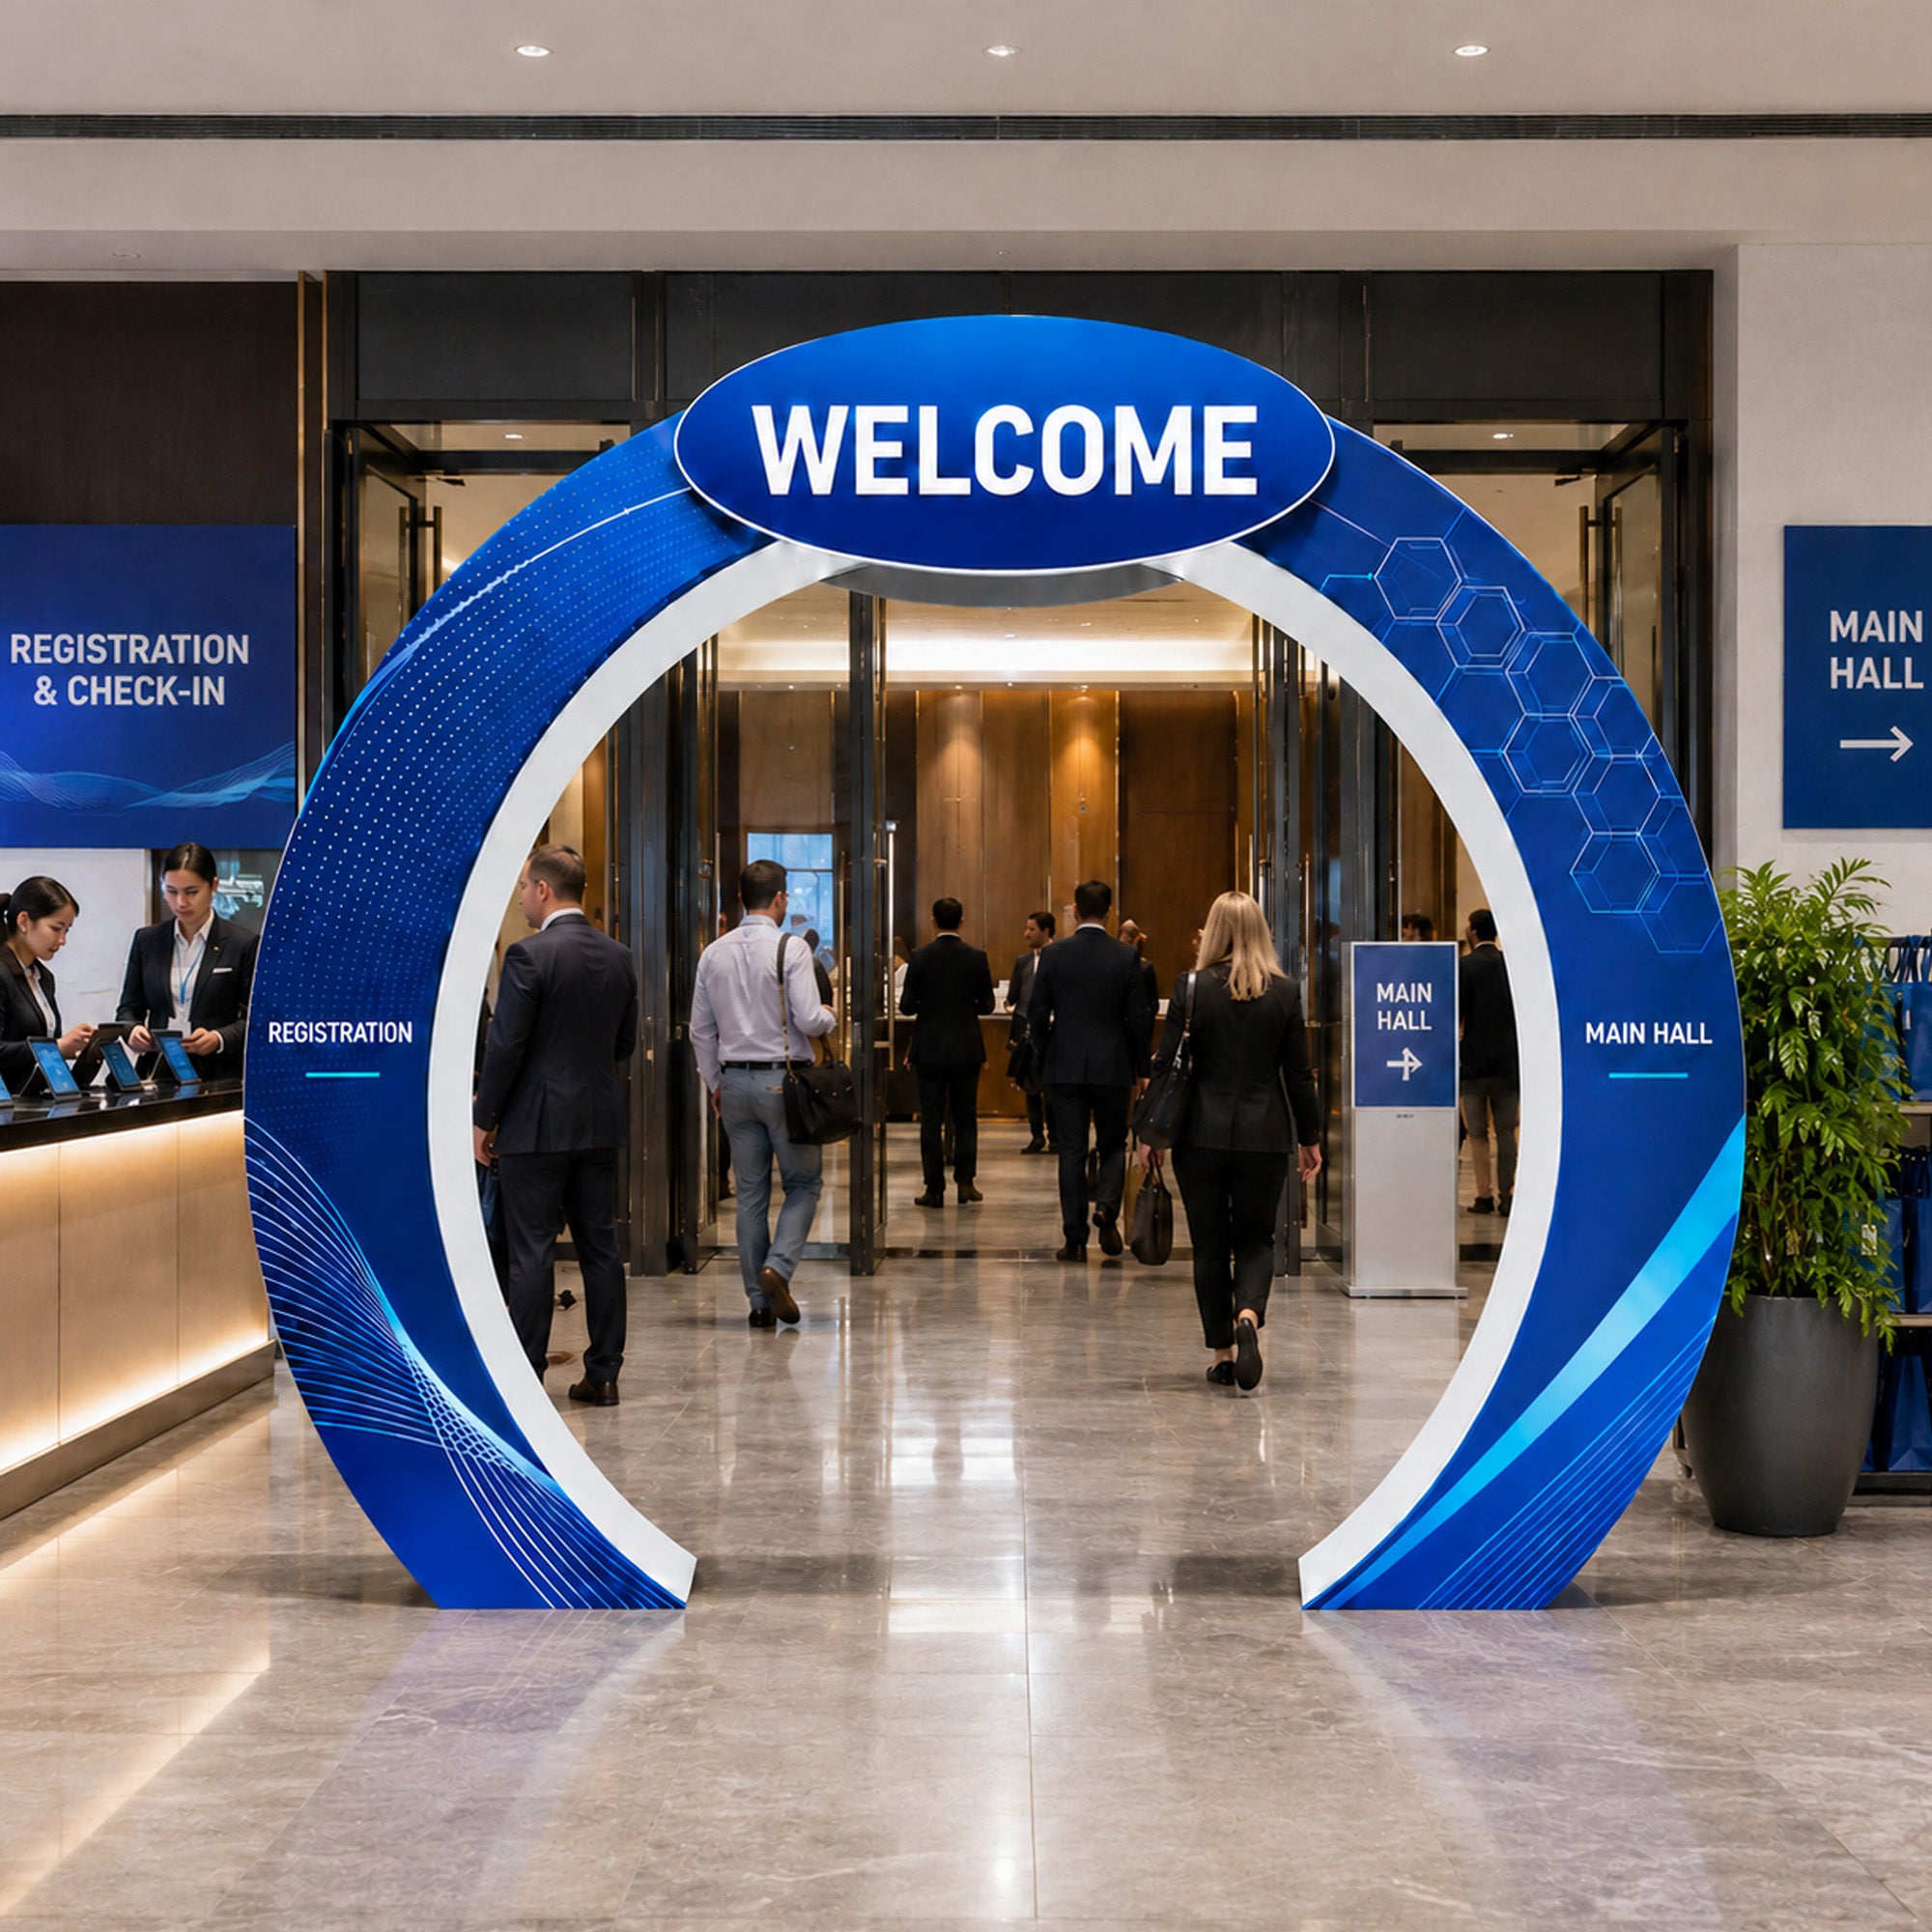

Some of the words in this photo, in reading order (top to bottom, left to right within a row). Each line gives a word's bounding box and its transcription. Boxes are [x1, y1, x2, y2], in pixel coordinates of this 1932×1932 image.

[752, 404, 1259, 497] WELCOME
[1830, 611, 1922, 642] MAIN
[10, 633, 249, 665] REGISTRATION
[1830, 656, 1924, 690] HALL
[33, 675, 58, 706] &
[67, 675, 225, 706] CHECK-IN
[1377, 982, 1433, 1004] MAIN
[268, 1020, 413, 1044] REGISTRATION
[1377, 1009, 1433, 1031] HALL
[1585, 1022, 1646, 1045] MAIN
[1653, 1021, 1714, 1045] HALL
